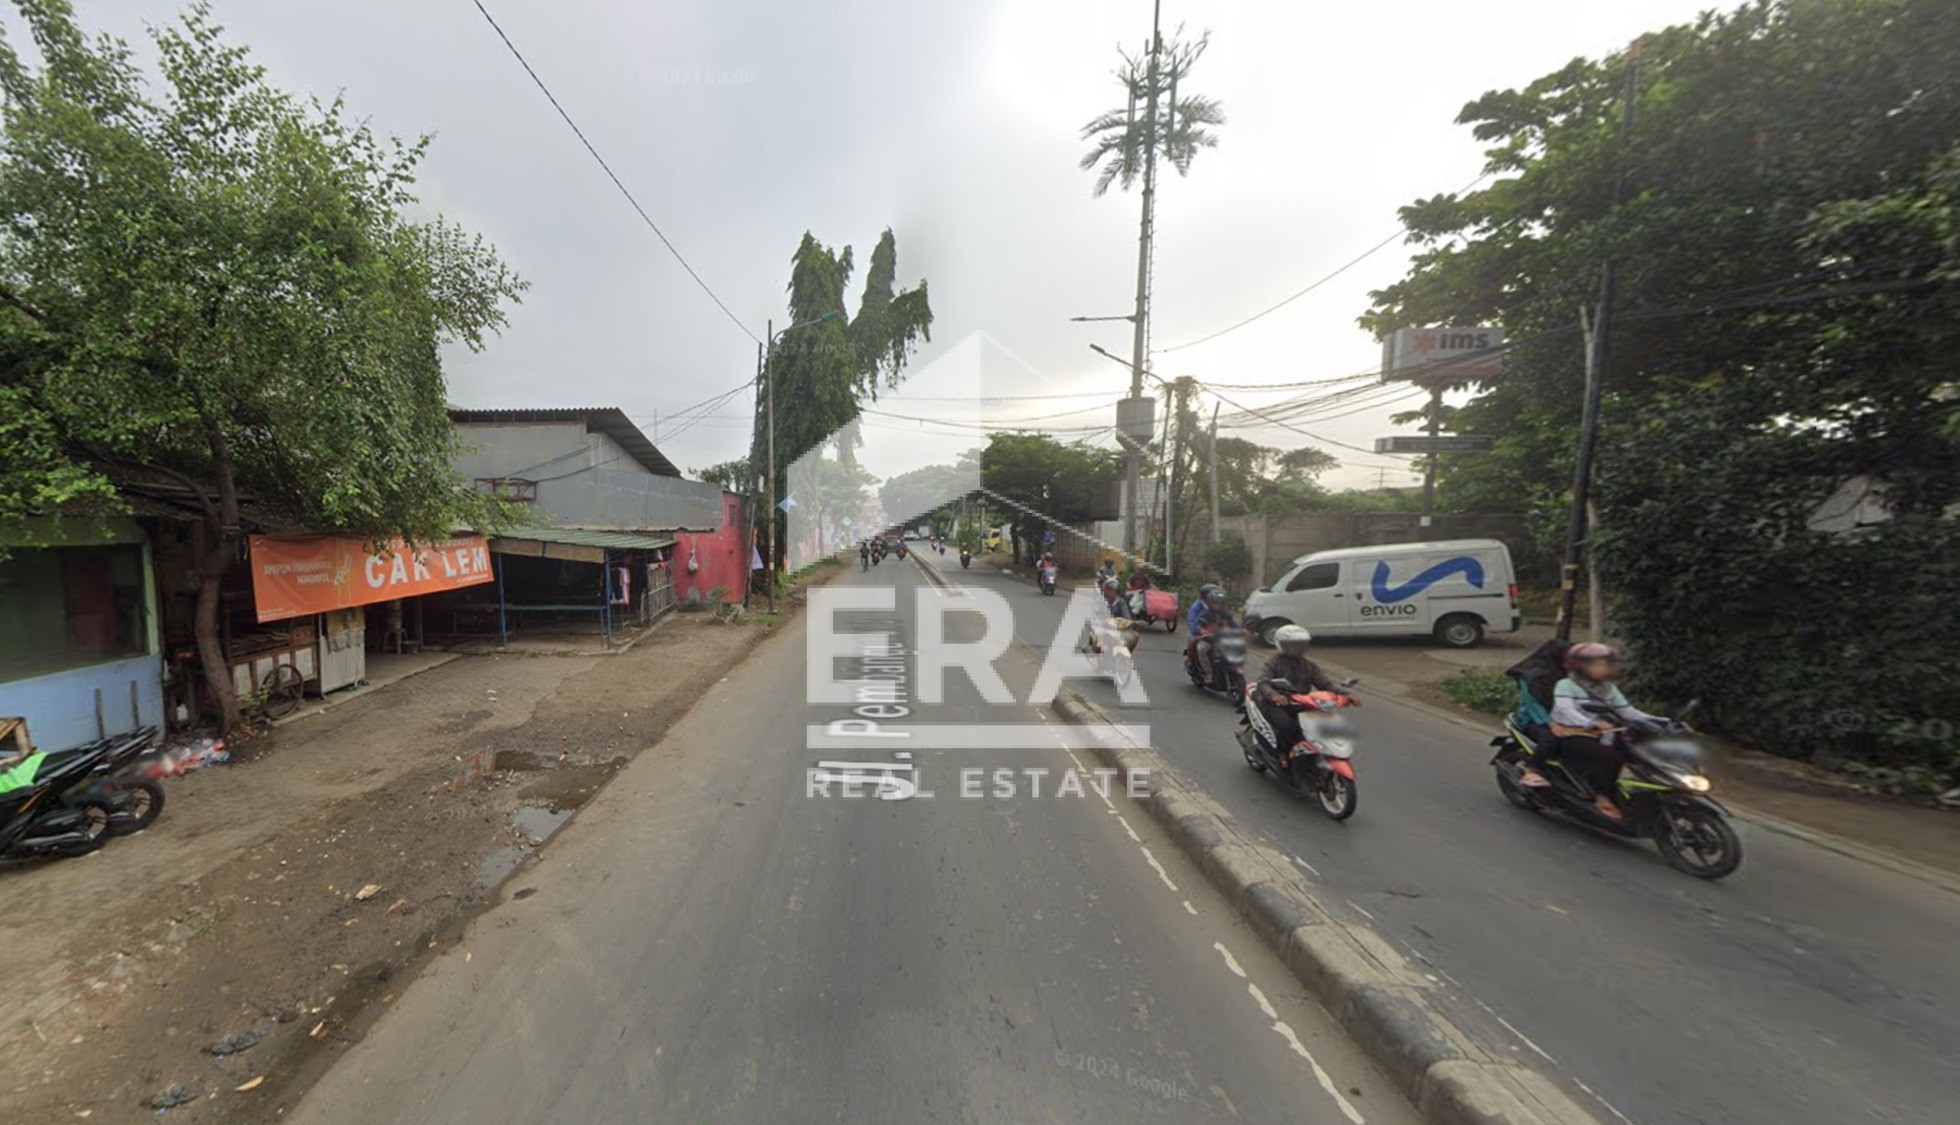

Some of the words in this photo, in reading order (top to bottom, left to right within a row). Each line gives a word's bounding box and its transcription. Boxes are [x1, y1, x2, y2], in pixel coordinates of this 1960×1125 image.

[1440, 332, 1489, 349] ims
[440, 546, 488, 578] LEM
[1360, 604, 1416, 617] envio
